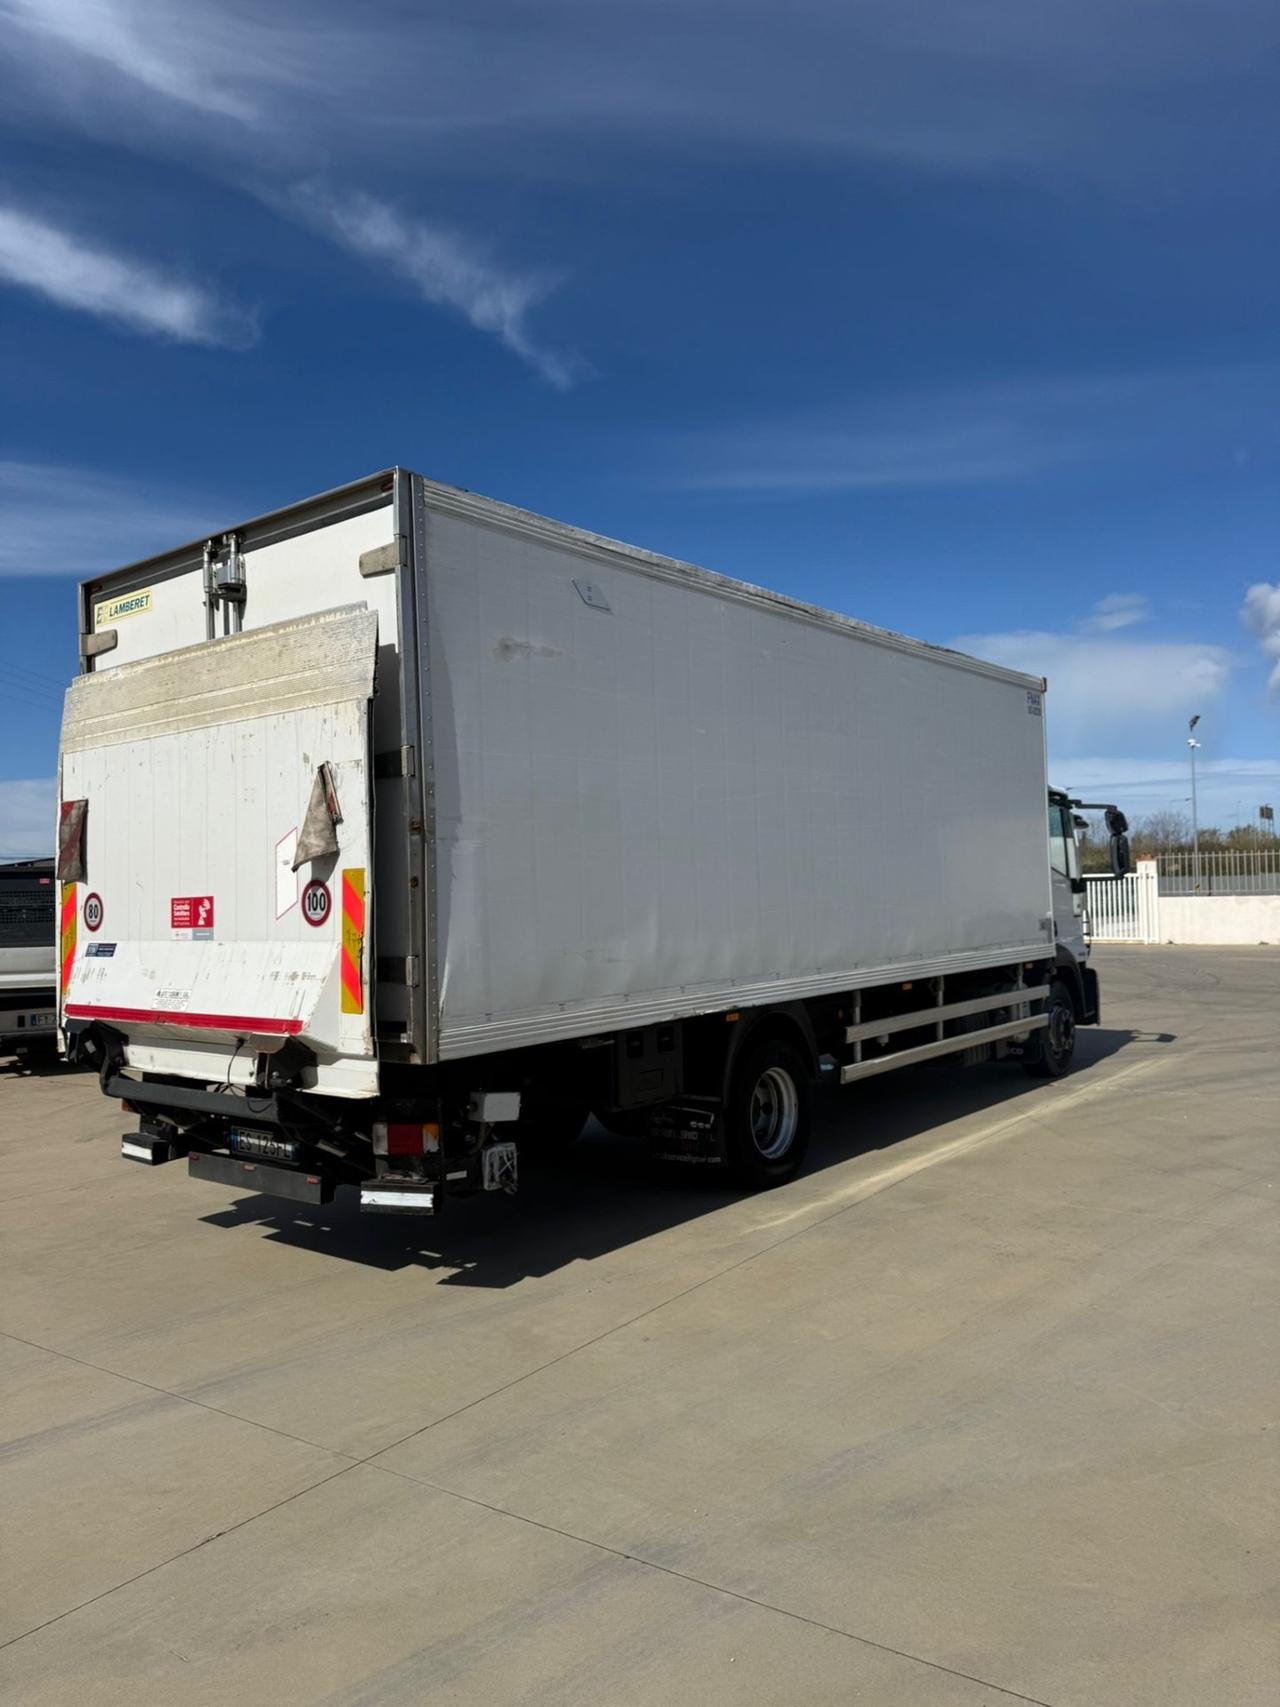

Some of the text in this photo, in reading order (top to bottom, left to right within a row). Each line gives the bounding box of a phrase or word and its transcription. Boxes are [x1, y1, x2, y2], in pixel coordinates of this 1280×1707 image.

[110, 594, 150, 617] LAMBERET
[88, 903, 99, 919] 80
[307, 892, 326, 912] 100
